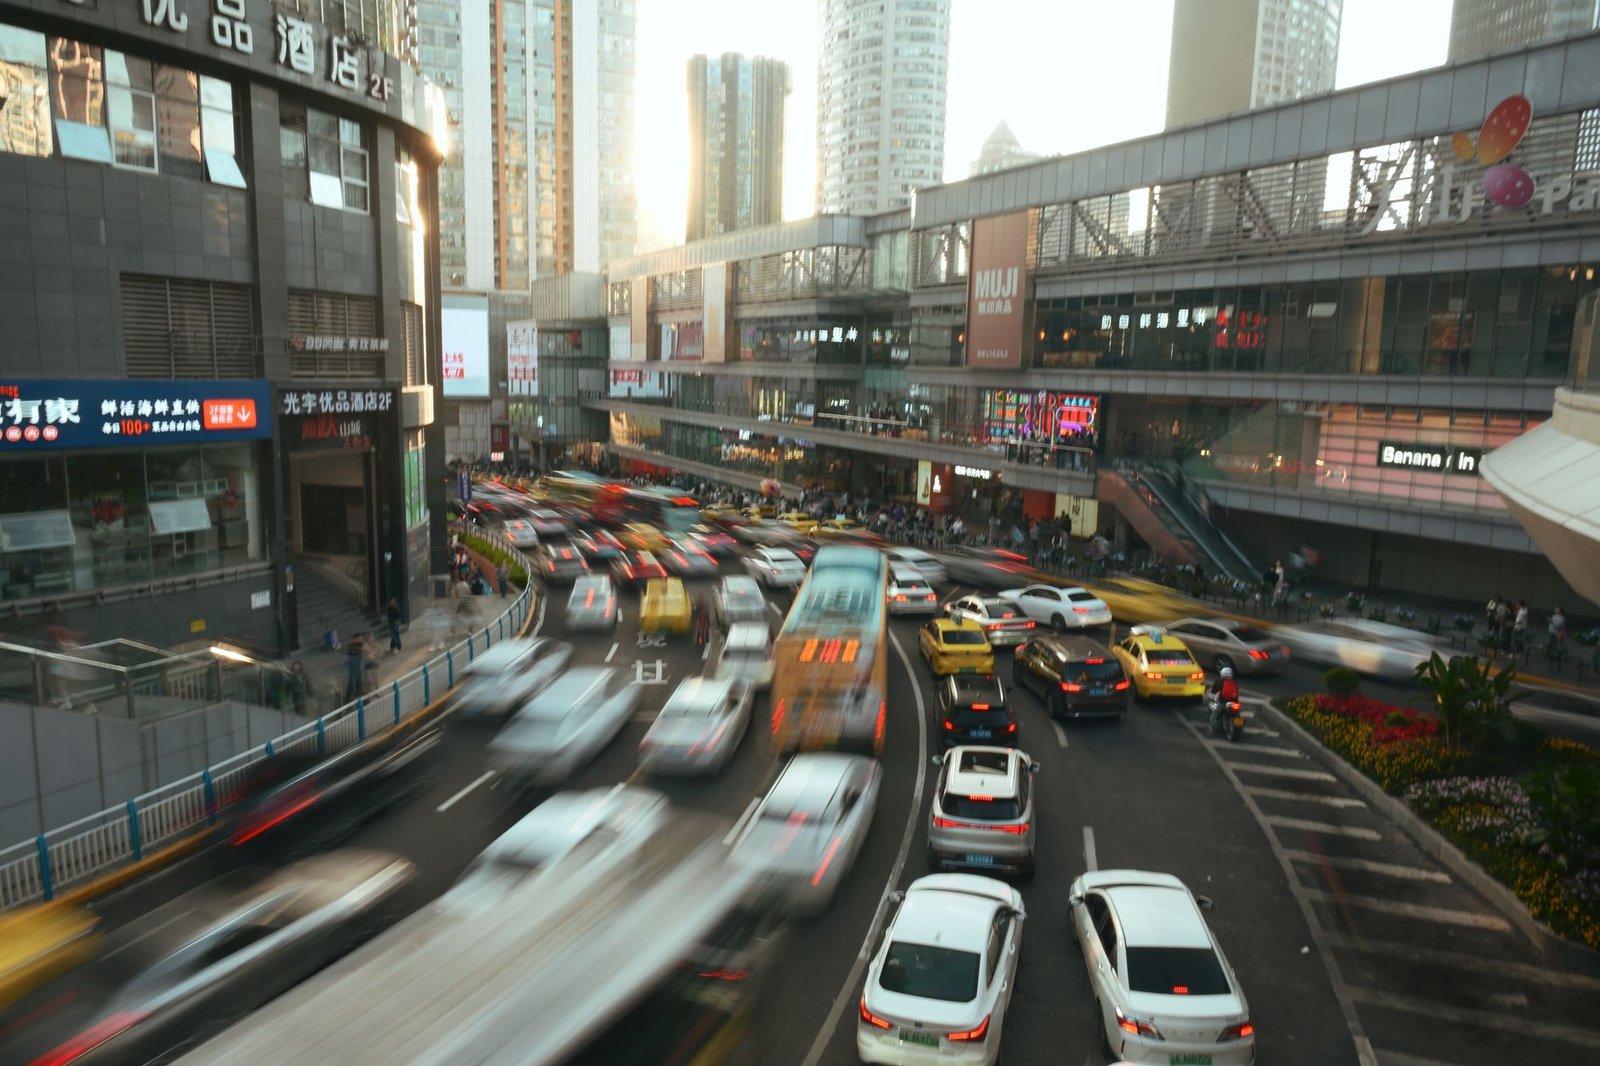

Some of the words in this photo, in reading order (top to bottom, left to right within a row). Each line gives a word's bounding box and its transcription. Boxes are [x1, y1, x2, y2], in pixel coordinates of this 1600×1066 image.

[370, 74, 394, 101] 2F
[975, 267, 1018, 300] MUJI
[101, 399, 200, 417] 鲜活海鲜直供
[284, 390, 392, 415] 光宇优品酒店2F
[1383, 446, 1441, 467] Banana
